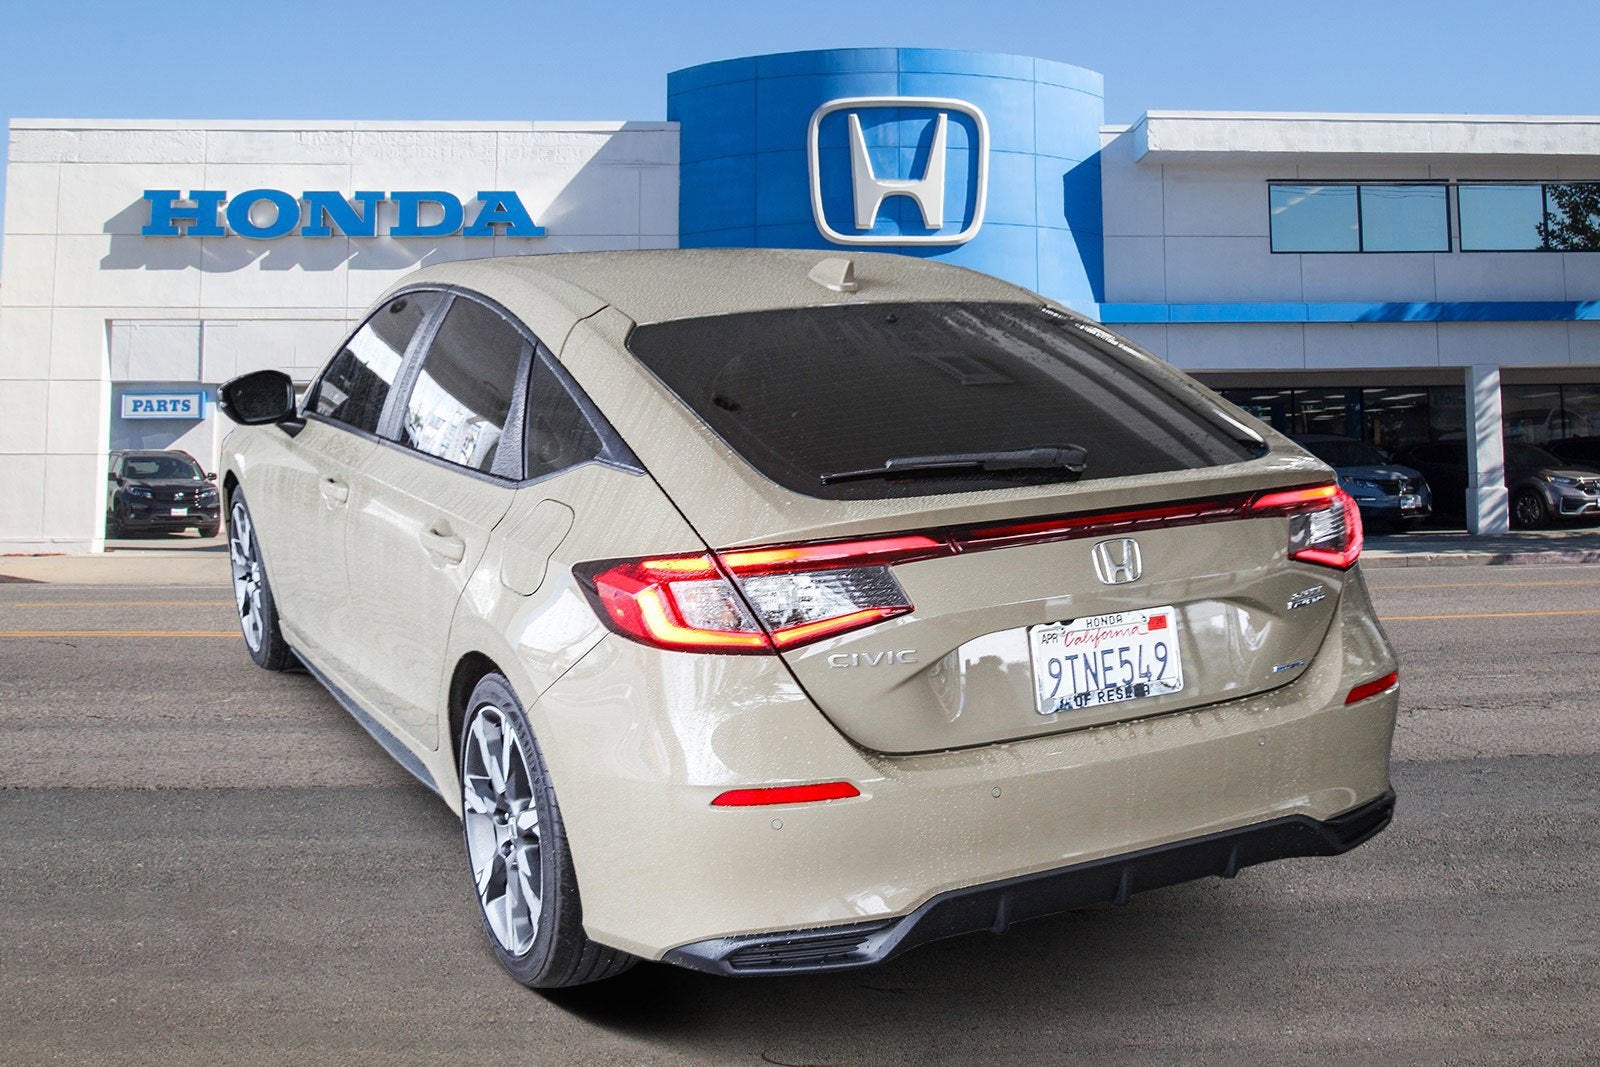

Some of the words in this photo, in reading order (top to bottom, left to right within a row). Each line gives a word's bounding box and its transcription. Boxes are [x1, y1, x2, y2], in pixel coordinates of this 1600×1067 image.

[141, 188, 547, 239] HONDA
[131, 399, 192, 413] PARTS
[1086, 614, 1123, 628] HONDA
[1041, 632, 1059, 645] APR
[1064, 625, 1148, 648] California
[827, 648, 917, 669] CIVIC
[1048, 641, 1168, 699] 9TNE549
